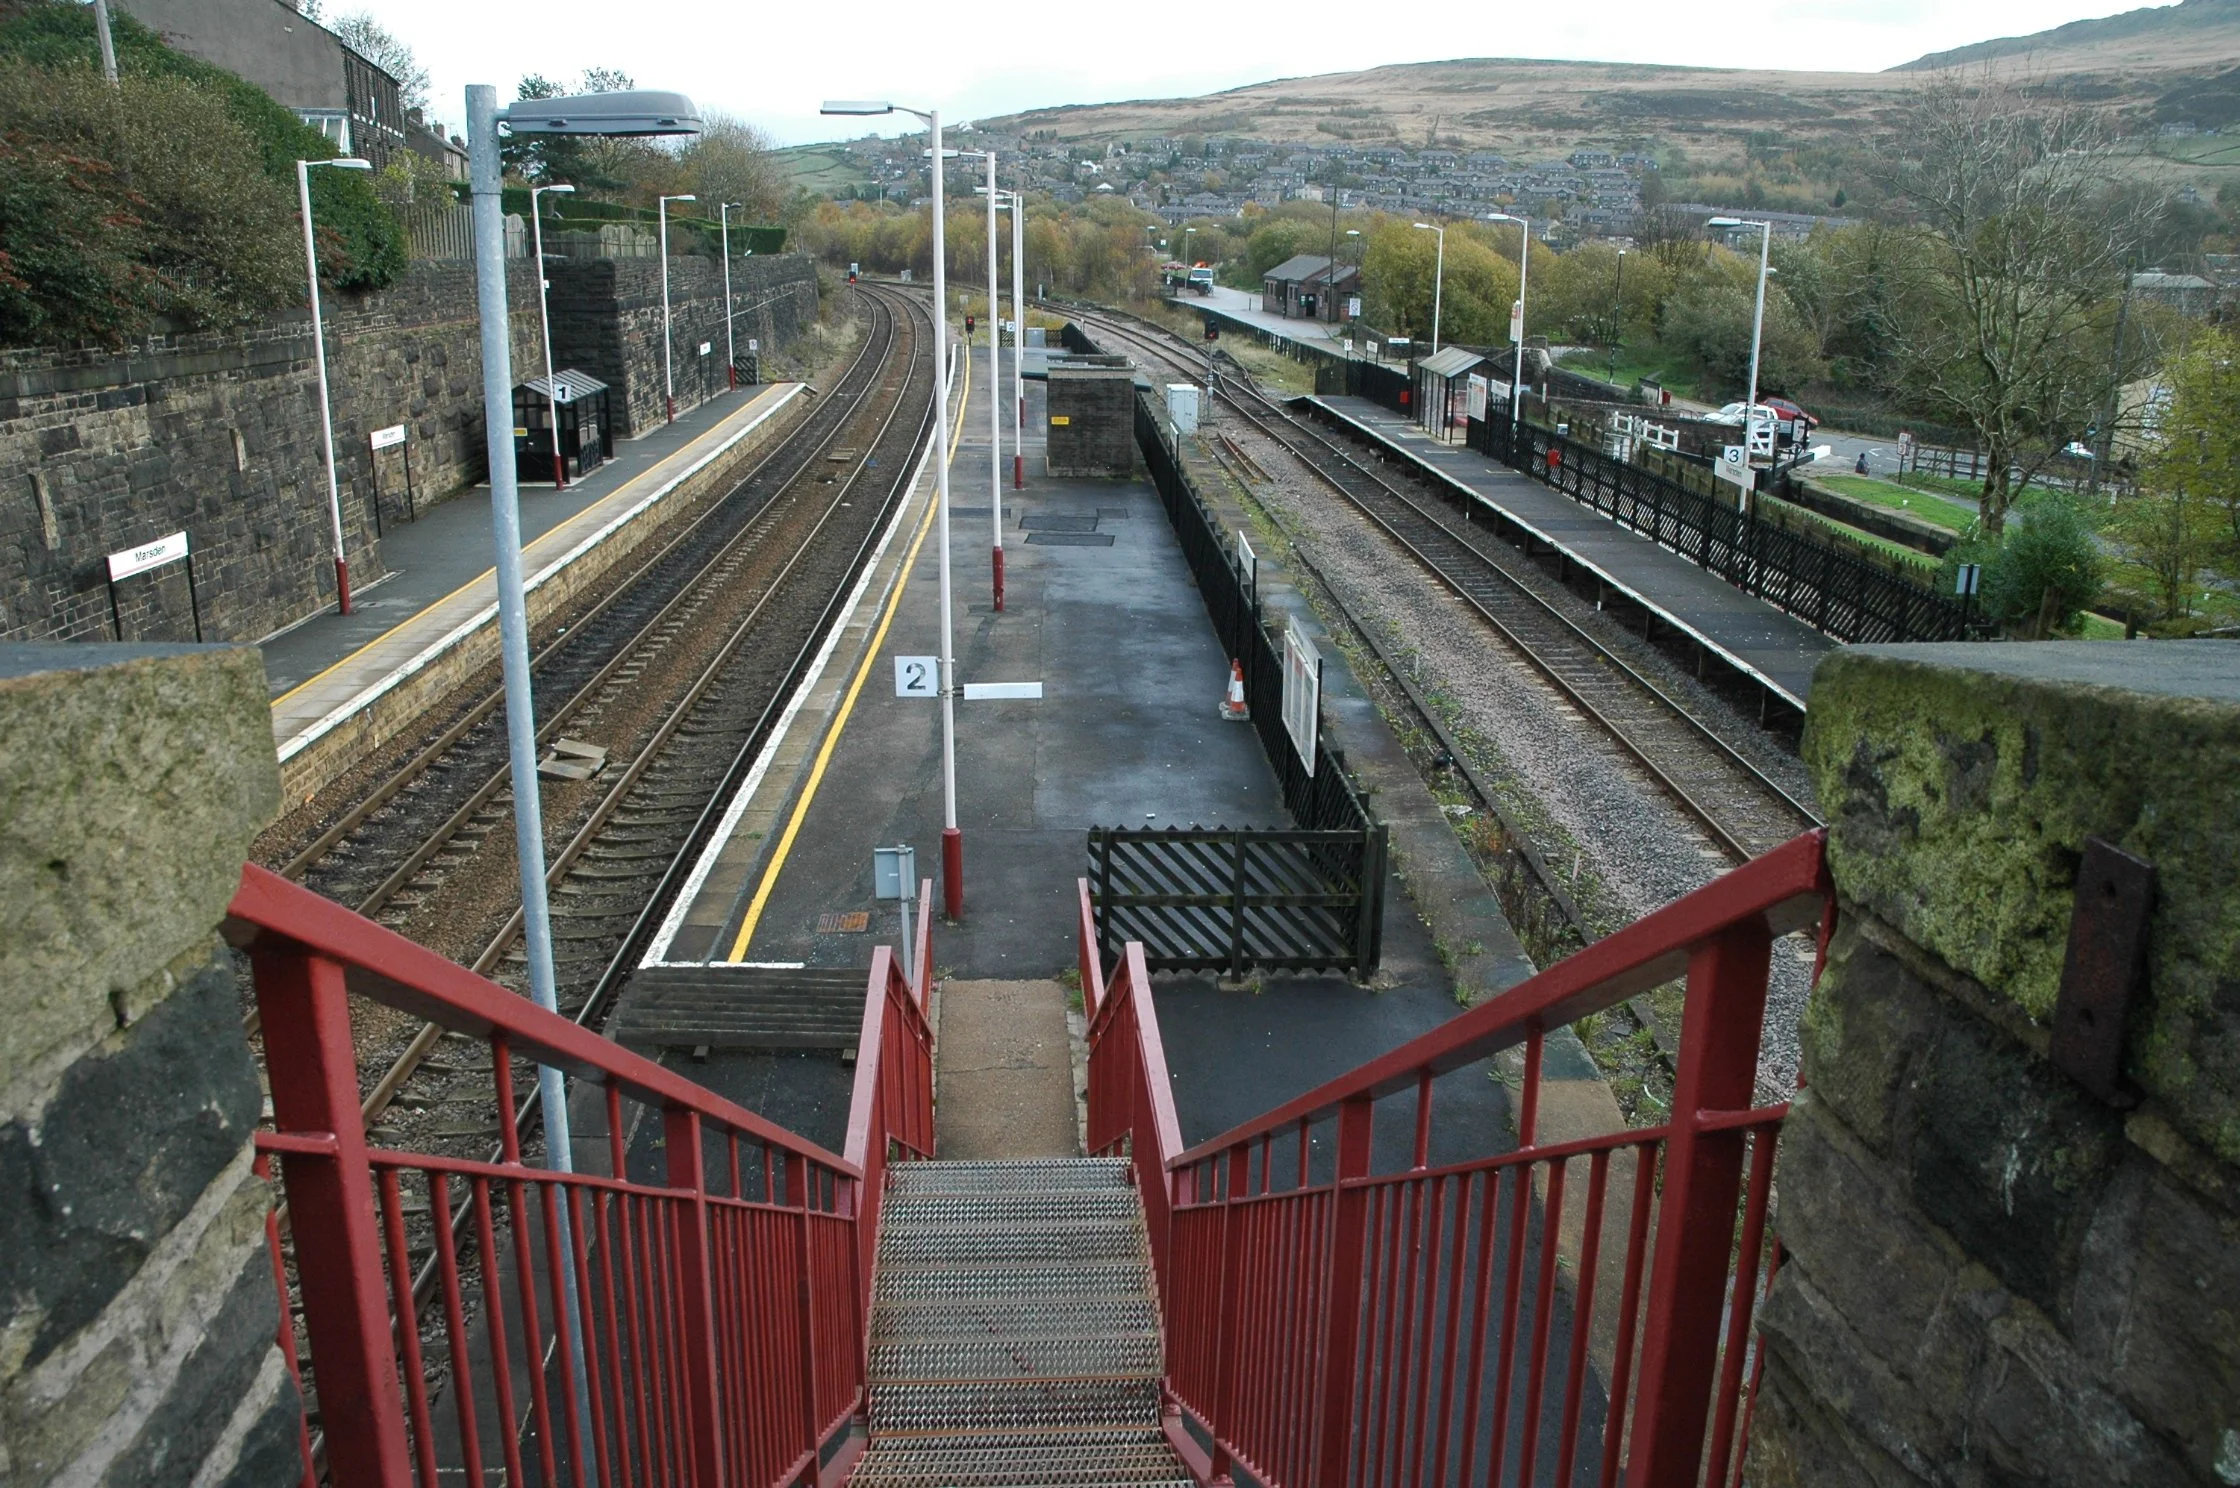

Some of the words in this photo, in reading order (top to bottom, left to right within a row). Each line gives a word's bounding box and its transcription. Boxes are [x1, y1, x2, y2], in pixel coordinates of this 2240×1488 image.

[558, 386, 566, 399] 1
[1728, 449, 1739, 463] 3
[135, 545, 166, 562] Marsden
[905, 662, 927, 691] 2
